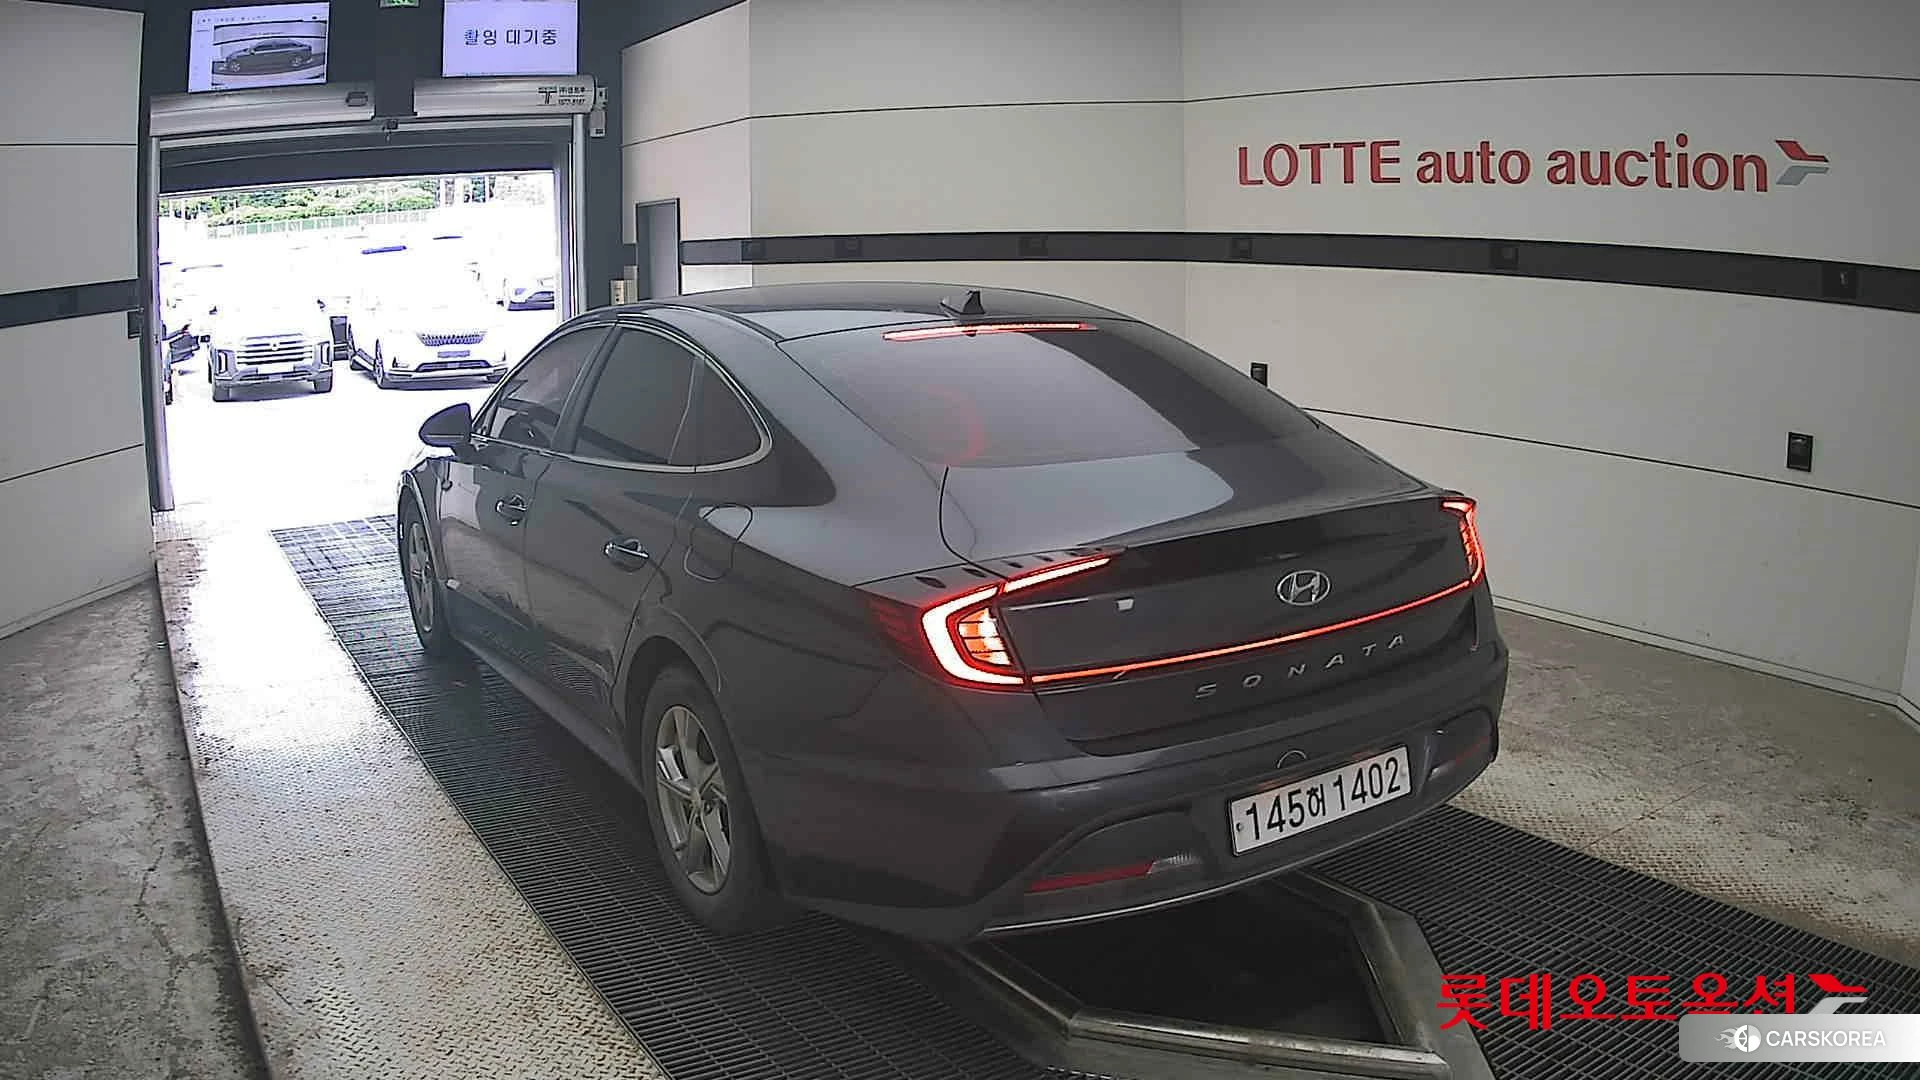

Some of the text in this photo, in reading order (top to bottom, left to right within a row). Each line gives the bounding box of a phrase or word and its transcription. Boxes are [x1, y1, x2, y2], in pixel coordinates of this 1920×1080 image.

[505, 29, 558, 46] 대기중
[1238, 132, 1768, 193] LOTTE auto auction
[1195, 634, 1405, 699] SONATA
